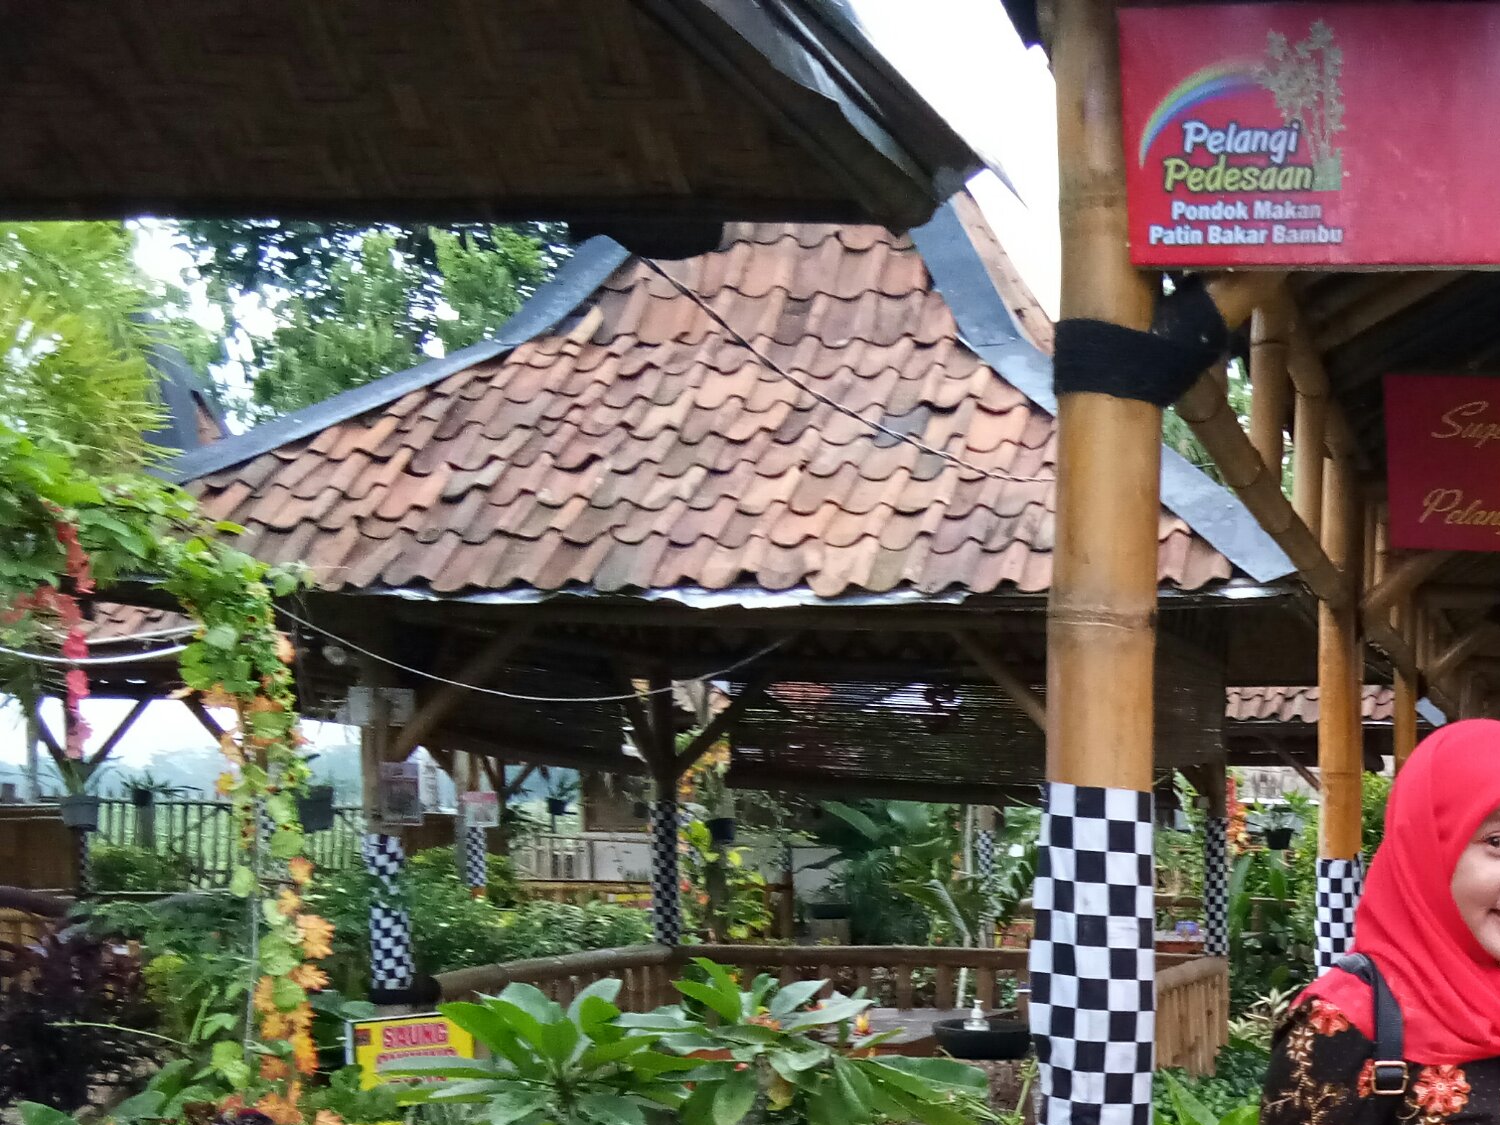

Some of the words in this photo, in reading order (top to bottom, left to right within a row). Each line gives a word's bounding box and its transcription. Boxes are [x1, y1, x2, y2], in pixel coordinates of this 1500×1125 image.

[1181, 119, 1301, 164] Pelangi
[1162, 153, 1316, 193] Pedesaan
[1171, 200, 1249, 221] Pondok
[1253, 200, 1323, 220] Makan
[1149, 225, 1204, 245] Patin
[1207, 224, 1269, 245] Bakar
[1271, 223, 1344, 244] Bambu
[382, 1022, 449, 1049] SAUNG
